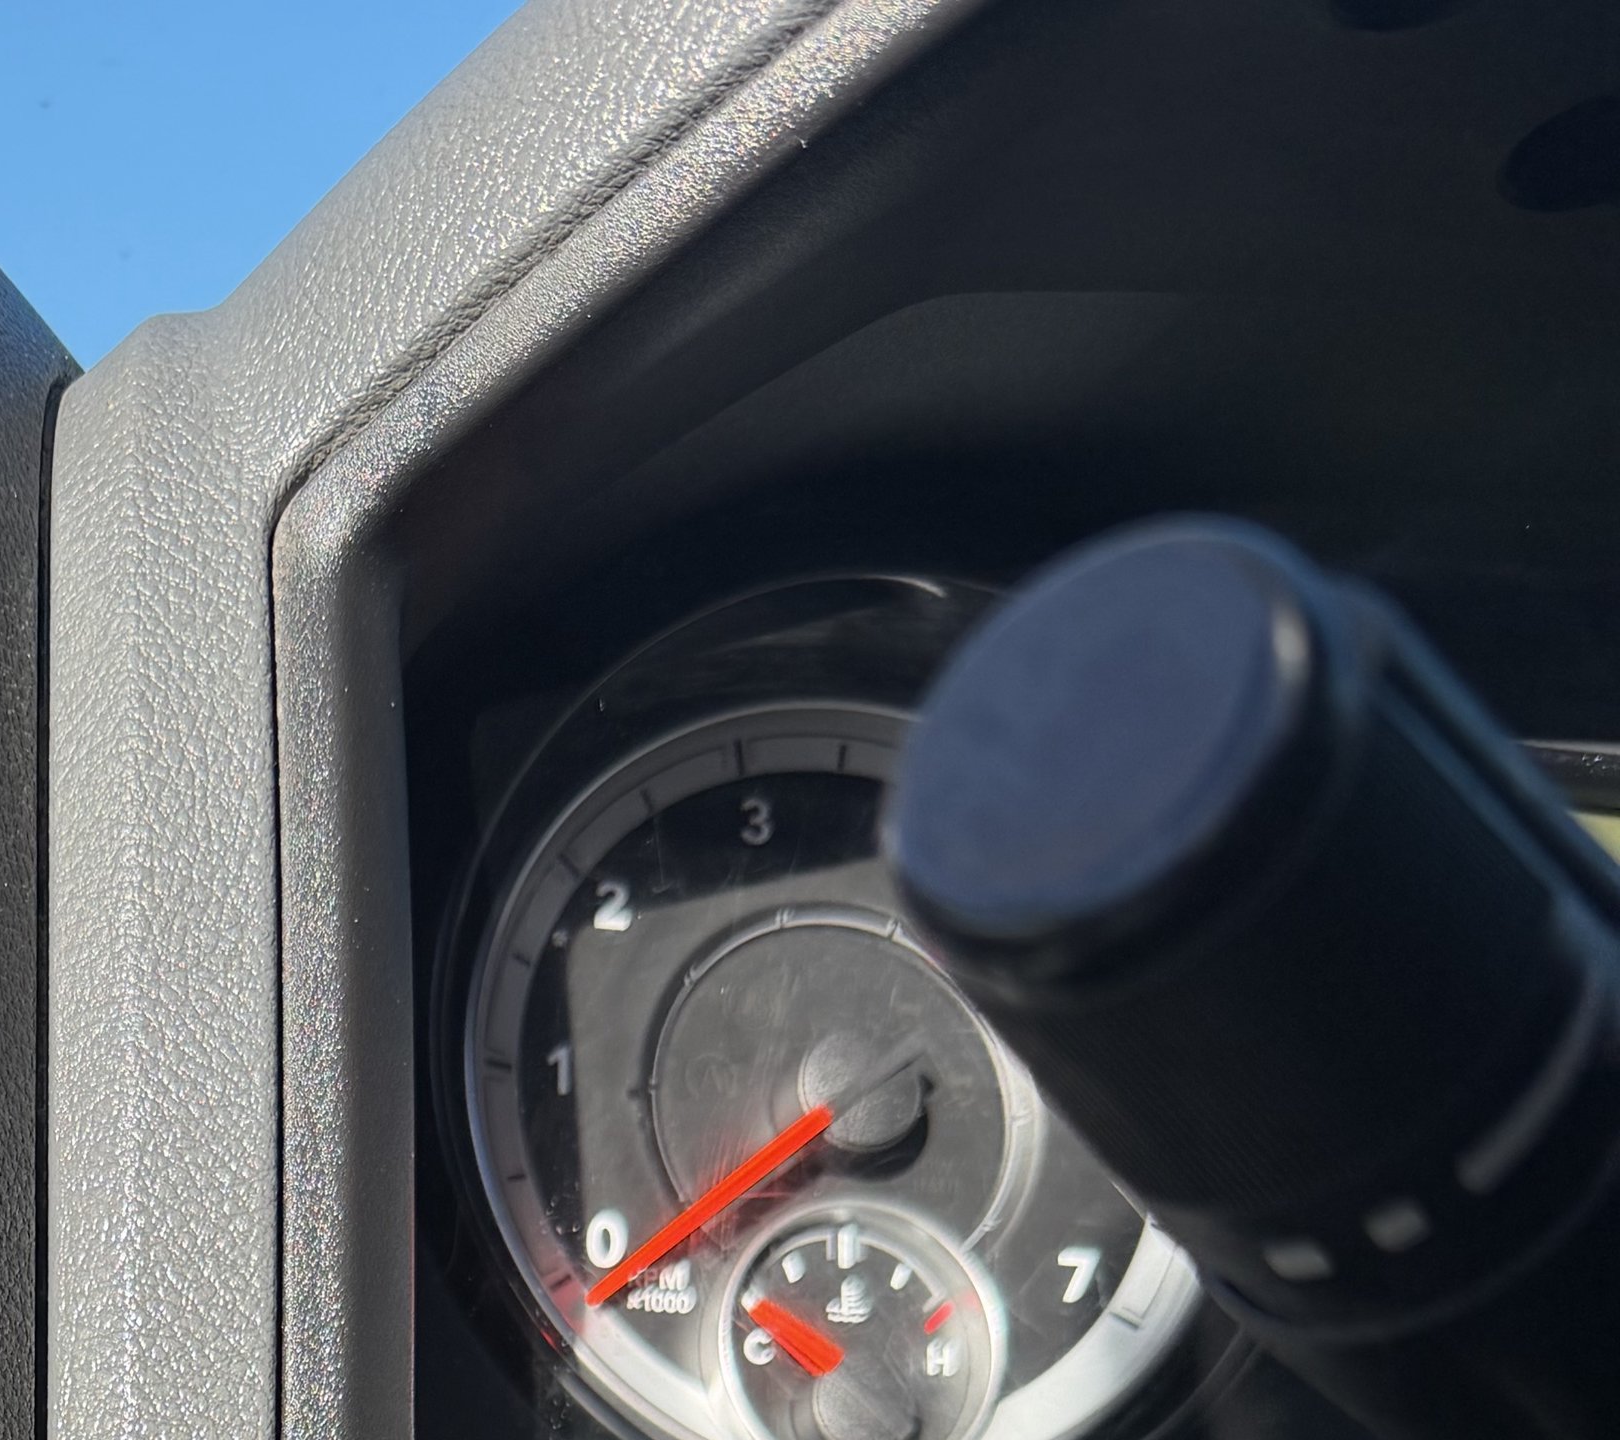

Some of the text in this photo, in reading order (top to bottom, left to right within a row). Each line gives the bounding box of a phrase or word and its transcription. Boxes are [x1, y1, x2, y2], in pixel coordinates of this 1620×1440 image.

[740, 797, 774, 847] 3
[593, 880, 634, 932] 2
[546, 1045, 574, 1097] 1
[586, 1209, 628, 1269] 0
[1056, 1245, 1101, 1303] 7
[925, 1336, 962, 1377] H
